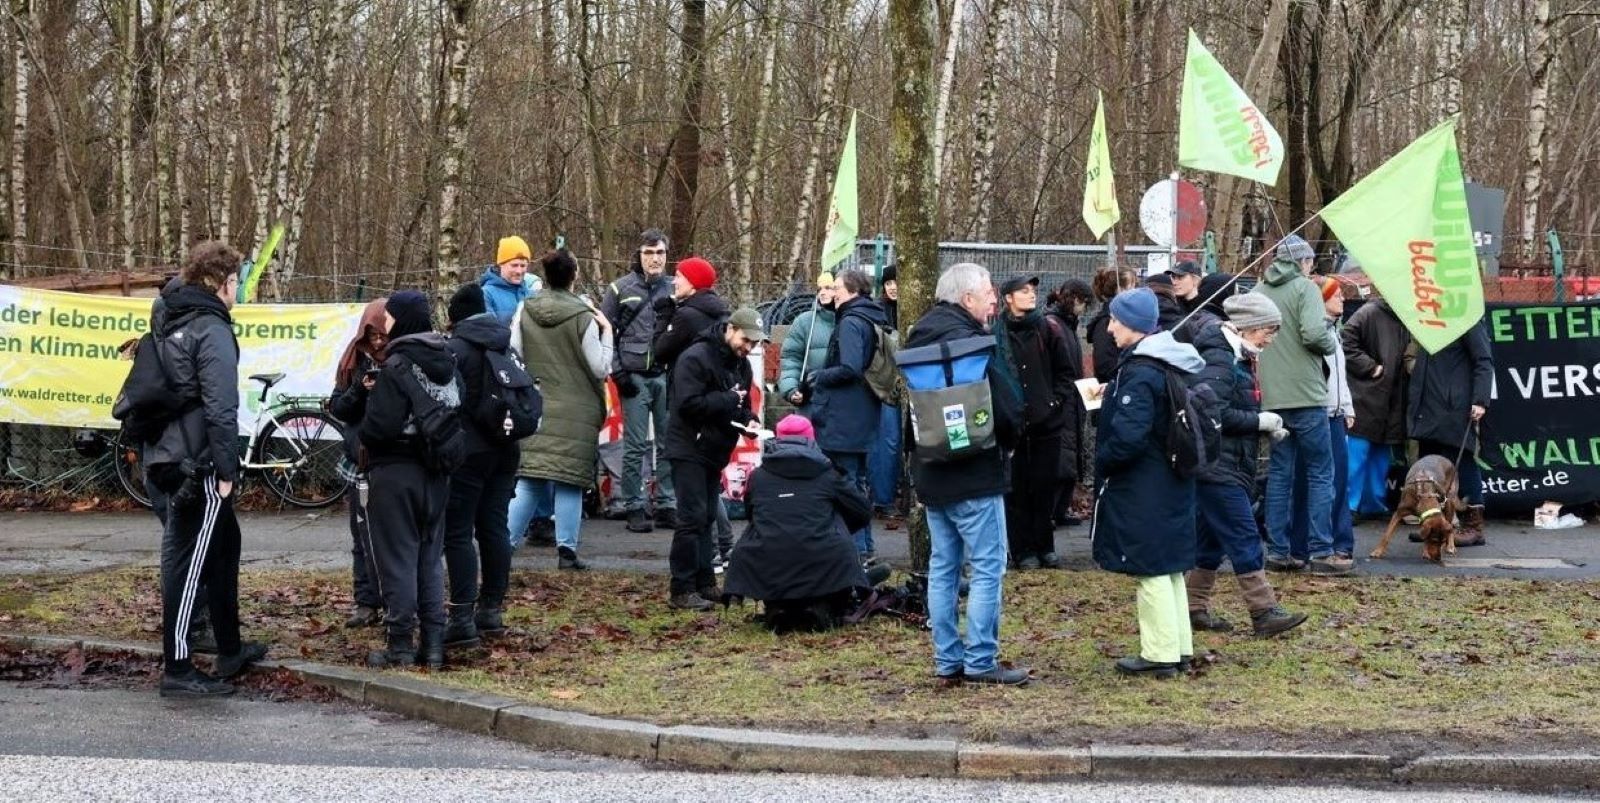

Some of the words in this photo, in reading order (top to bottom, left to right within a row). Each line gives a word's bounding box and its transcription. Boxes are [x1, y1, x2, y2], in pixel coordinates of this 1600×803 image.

[1408, 239, 1447, 329] bleibt!
[1, 303, 42, 325] der
[49, 307, 147, 332] lebende
[0, 387, 112, 404] w.waldretter.de
